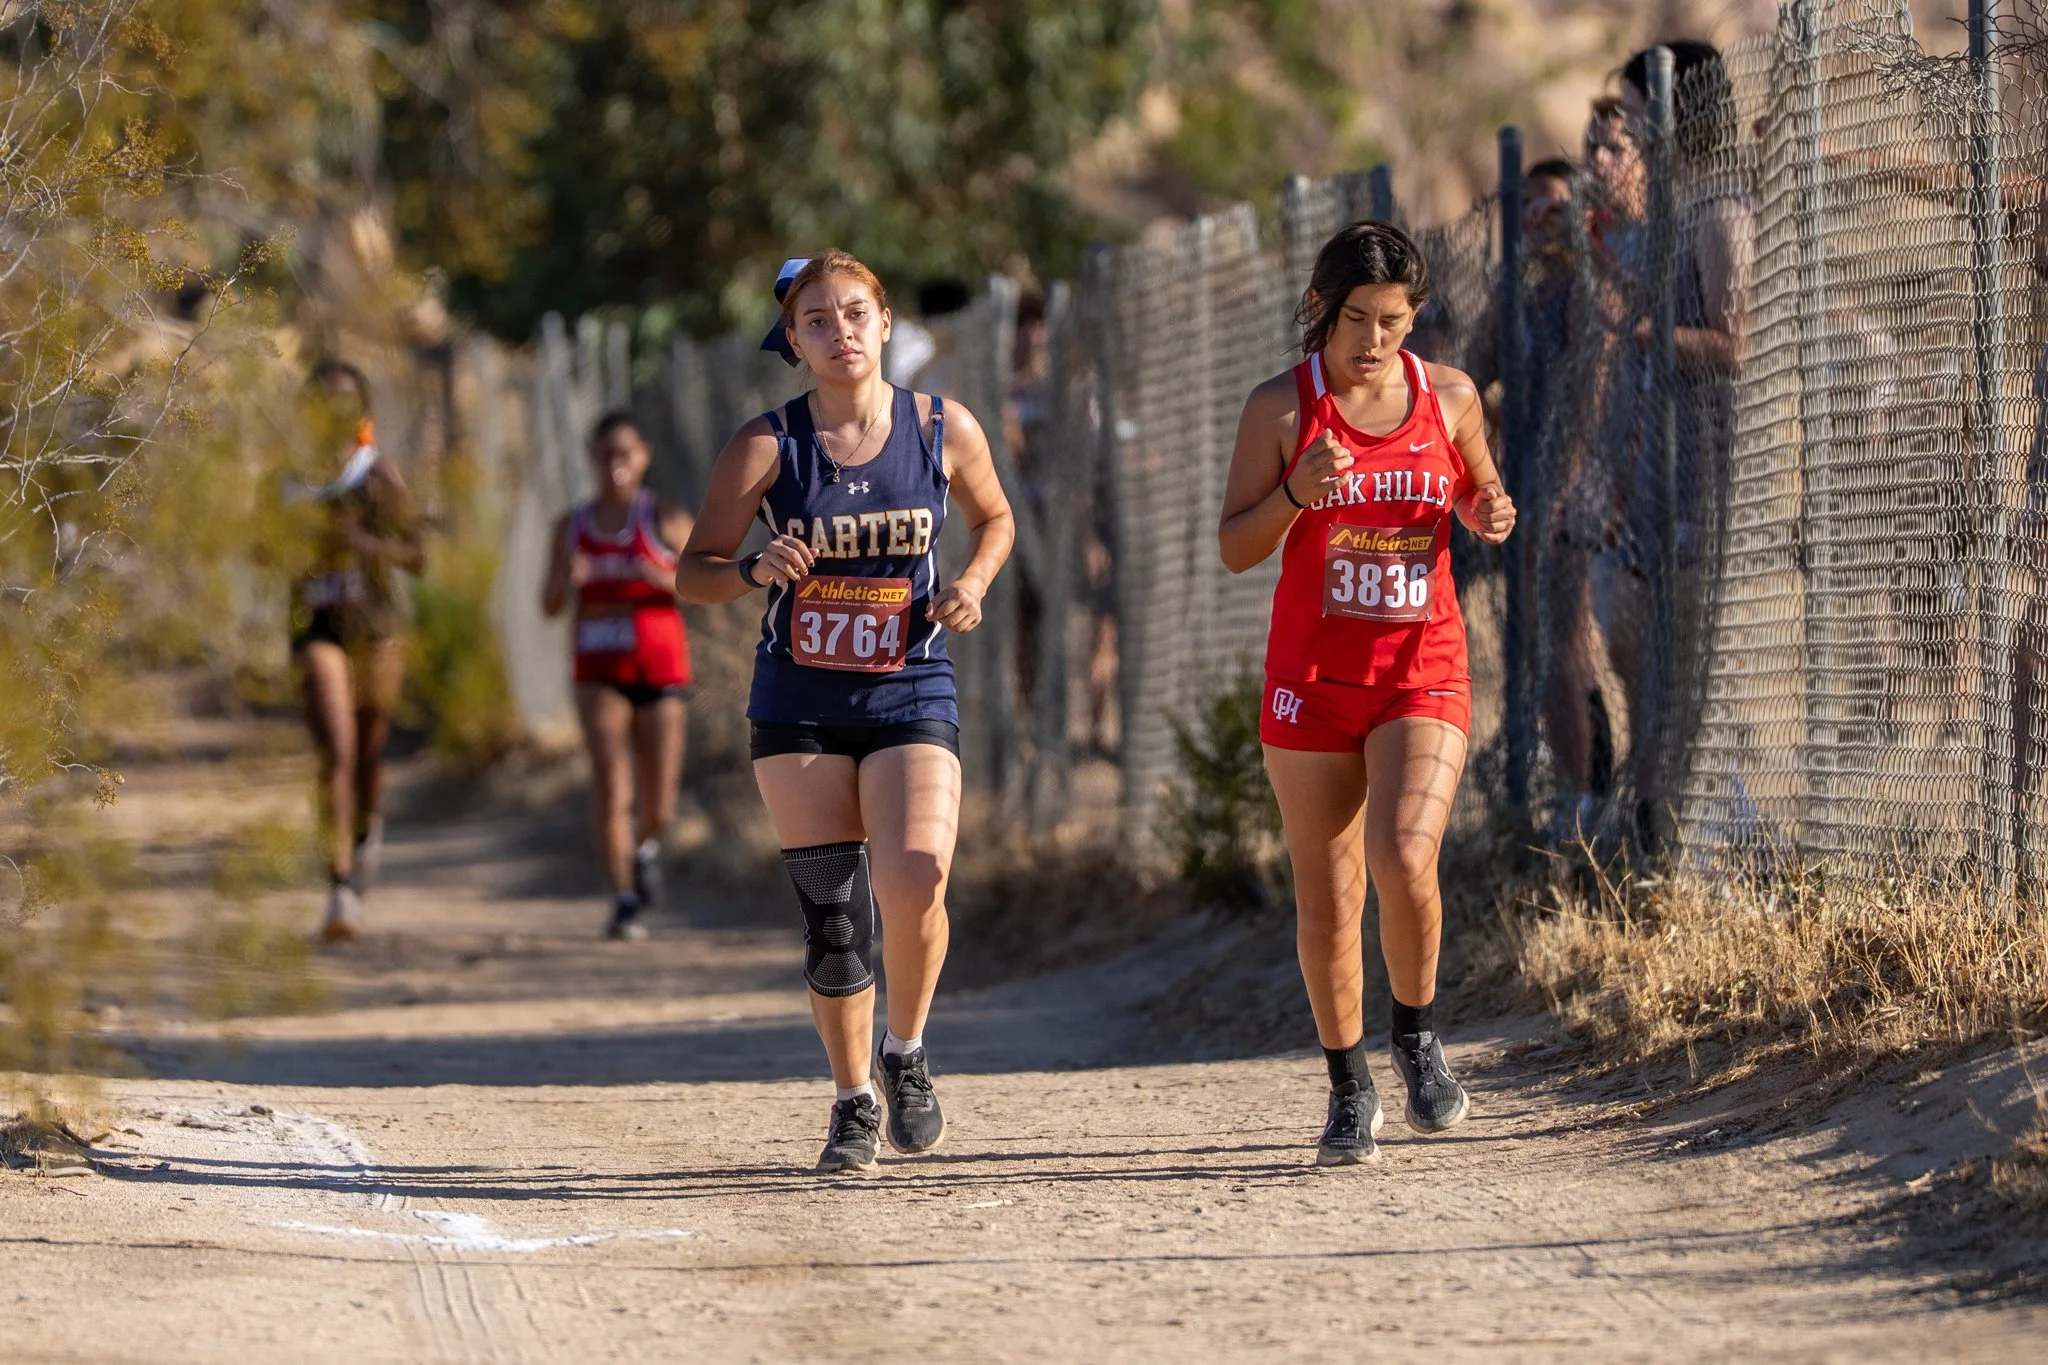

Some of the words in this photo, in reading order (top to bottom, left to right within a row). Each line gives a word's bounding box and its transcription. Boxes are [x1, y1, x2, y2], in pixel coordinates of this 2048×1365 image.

[1372, 470, 1449, 507] HILLS
[1331, 559, 1428, 608] 3836
[799, 611, 901, 658] 3764
